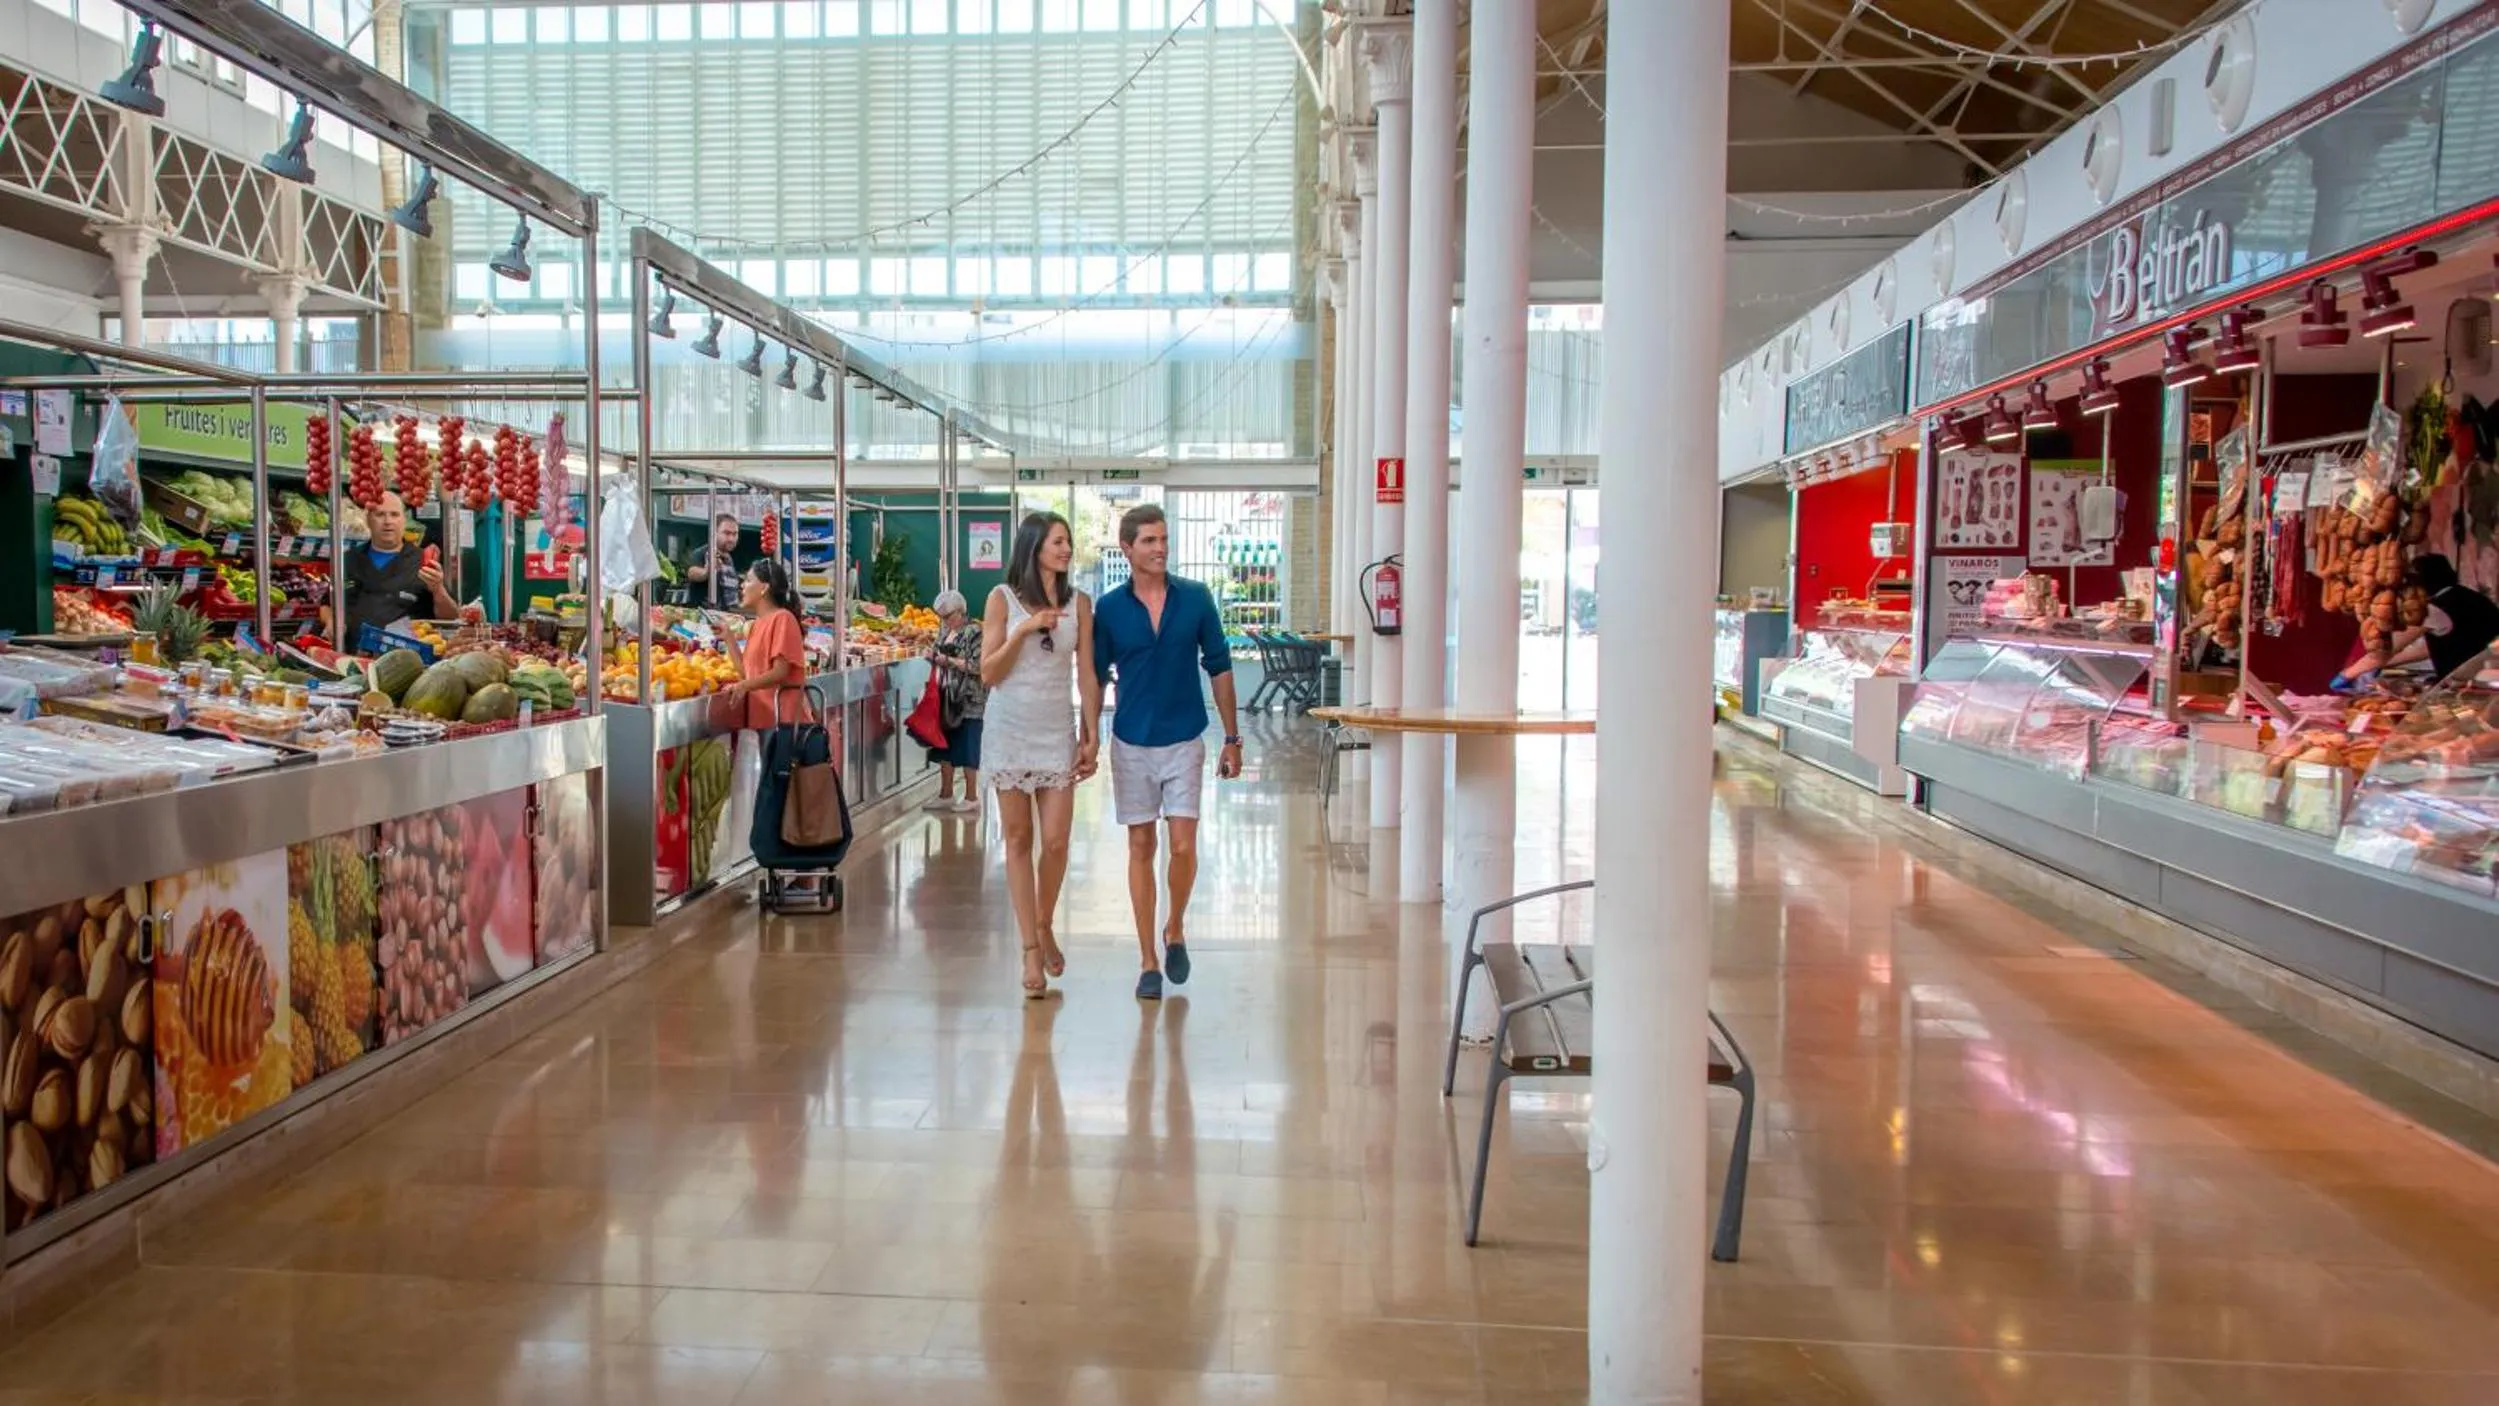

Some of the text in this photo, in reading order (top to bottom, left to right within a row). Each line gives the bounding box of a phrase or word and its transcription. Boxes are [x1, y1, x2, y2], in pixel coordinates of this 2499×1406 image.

[2107, 208, 2232, 323] Beltrán
[165, 405, 288, 445] Fruites i verres
